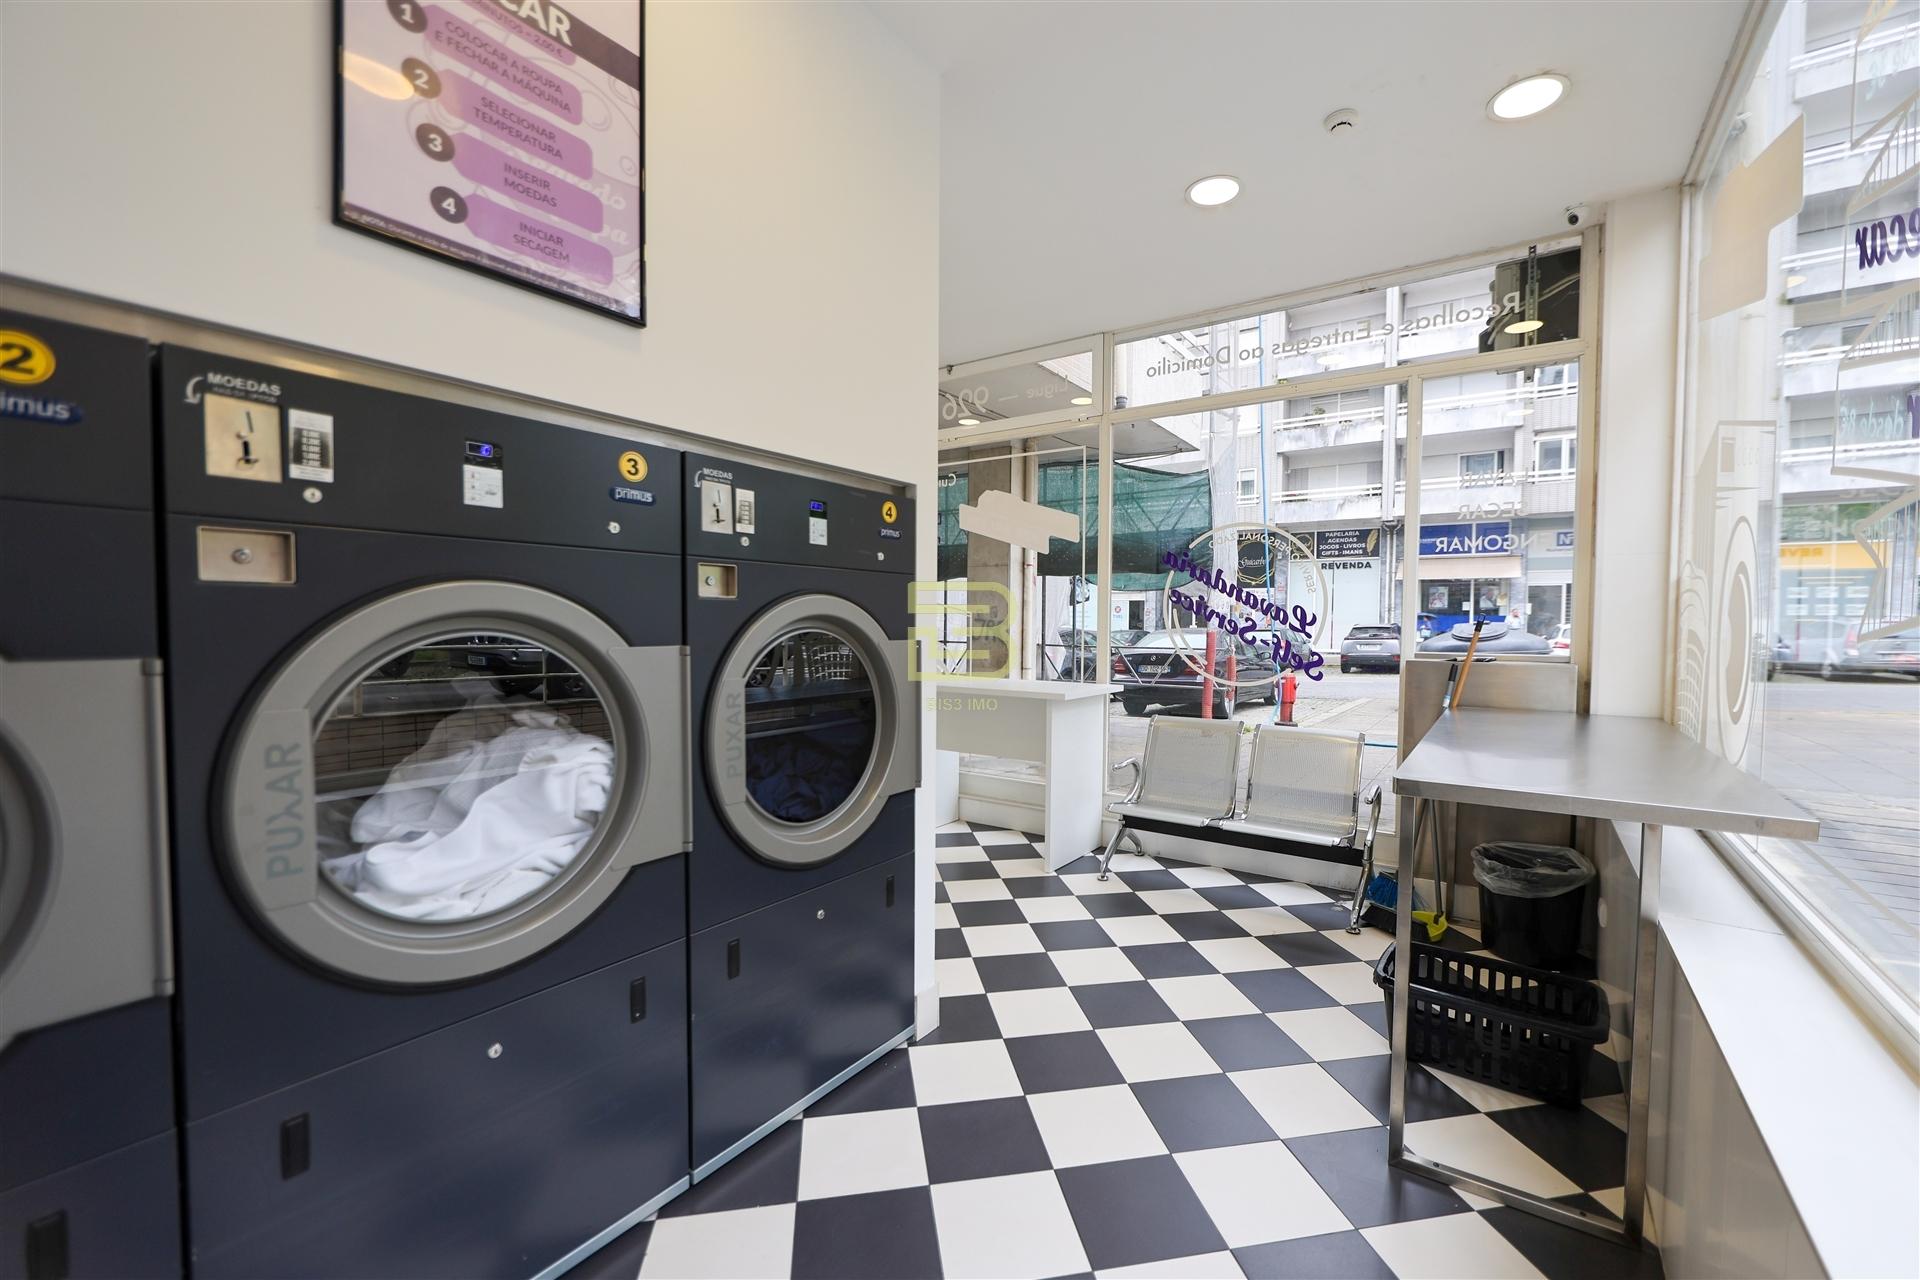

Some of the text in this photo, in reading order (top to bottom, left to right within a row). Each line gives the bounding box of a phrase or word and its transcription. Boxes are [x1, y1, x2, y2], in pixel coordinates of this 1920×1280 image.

[401, 5, 414, 24] 1
[445, 21, 563, 94] COLOCAR A ROUPA
[414, 69, 430, 89] 2
[435, 30, 572, 114] E FECHAR A MÁQUINA
[480, 97, 557, 143] SELECIONAR
[428, 134, 443, 153] 3
[473, 106, 563, 160] TEMPERATURA
[504, 163, 550, 191] INSERIR
[504, 178, 557, 207] MOEDAS
[441, 197, 456, 215] 4
[519, 222, 564, 247] INICIAR
[512, 234, 570, 263] SECAGEM
[0, 342, 35, 375] 2
[207, 372, 282, 396] MOEDAS
[626, 458, 639, 476] 3
[702, 468, 733, 480] MOEDAS
[615, 486, 653, 503] primus
[886, 506, 893, 519] 4
[880, 528, 900, 539] primus
[1325, 530, 1360, 538] PAPELARIA
[1321, 561, 1372, 569] REVENDA
[725, 692, 742, 779] PUXAR
[265, 742, 303, 880] PUXAR
